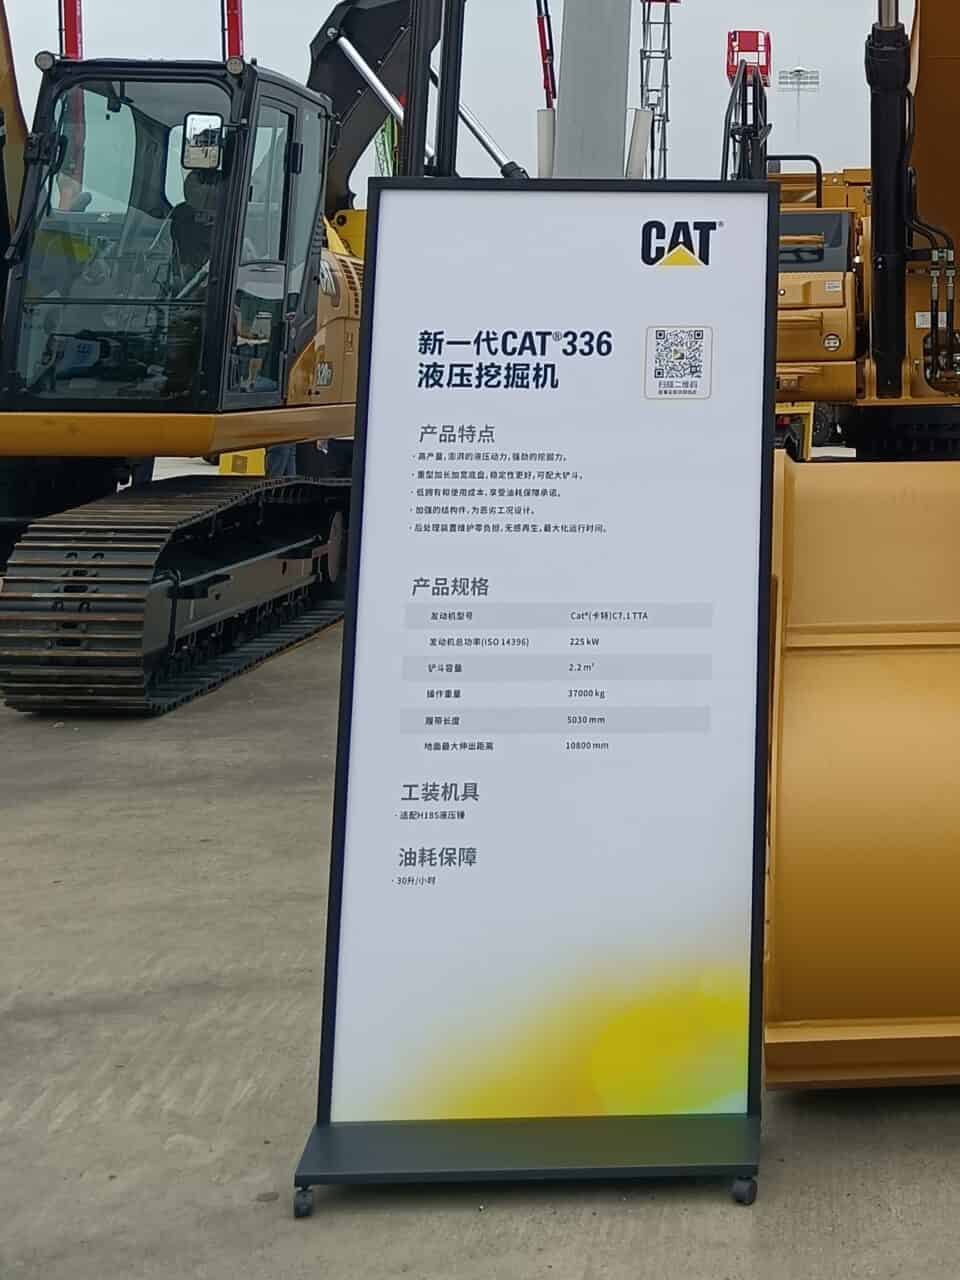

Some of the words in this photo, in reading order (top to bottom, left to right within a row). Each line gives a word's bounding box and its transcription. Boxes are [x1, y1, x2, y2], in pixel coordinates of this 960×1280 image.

[417, 362, 559, 389] 液压挖掘机
[419, 424, 496, 444] 产品特点
[412, 577, 489, 597] 产品规格
[570, 637, 585, 646] 225
[586, 637, 600, 646] kW
[568, 663, 582, 672] 2.2
[594, 688, 606, 699] kg
[588, 716, 606, 725] mm
[592, 742, 609, 750] mm
[401, 782, 480, 802] 工装机具
[399, 846, 479, 867] 油耗保障
